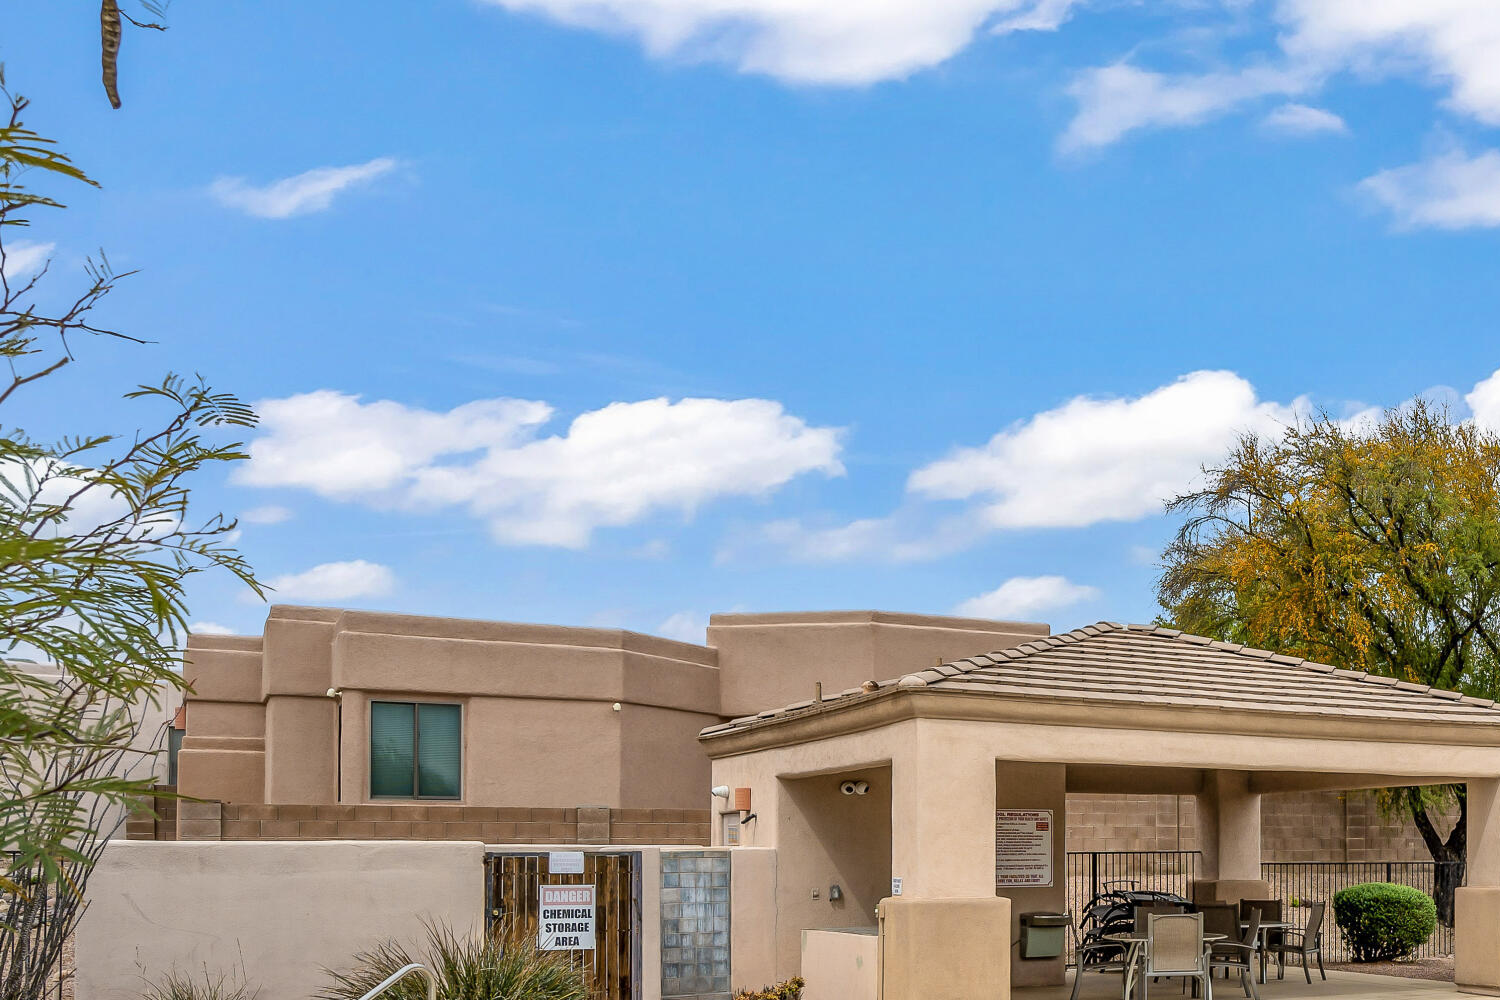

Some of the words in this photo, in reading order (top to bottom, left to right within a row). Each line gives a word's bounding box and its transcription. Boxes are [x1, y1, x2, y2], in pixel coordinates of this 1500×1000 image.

[545, 890, 591, 902] DANGER
[543, 909, 592, 919] CHEMICAL
[545, 922, 590, 933] STORAGE
[555, 936, 579, 946] AREA
